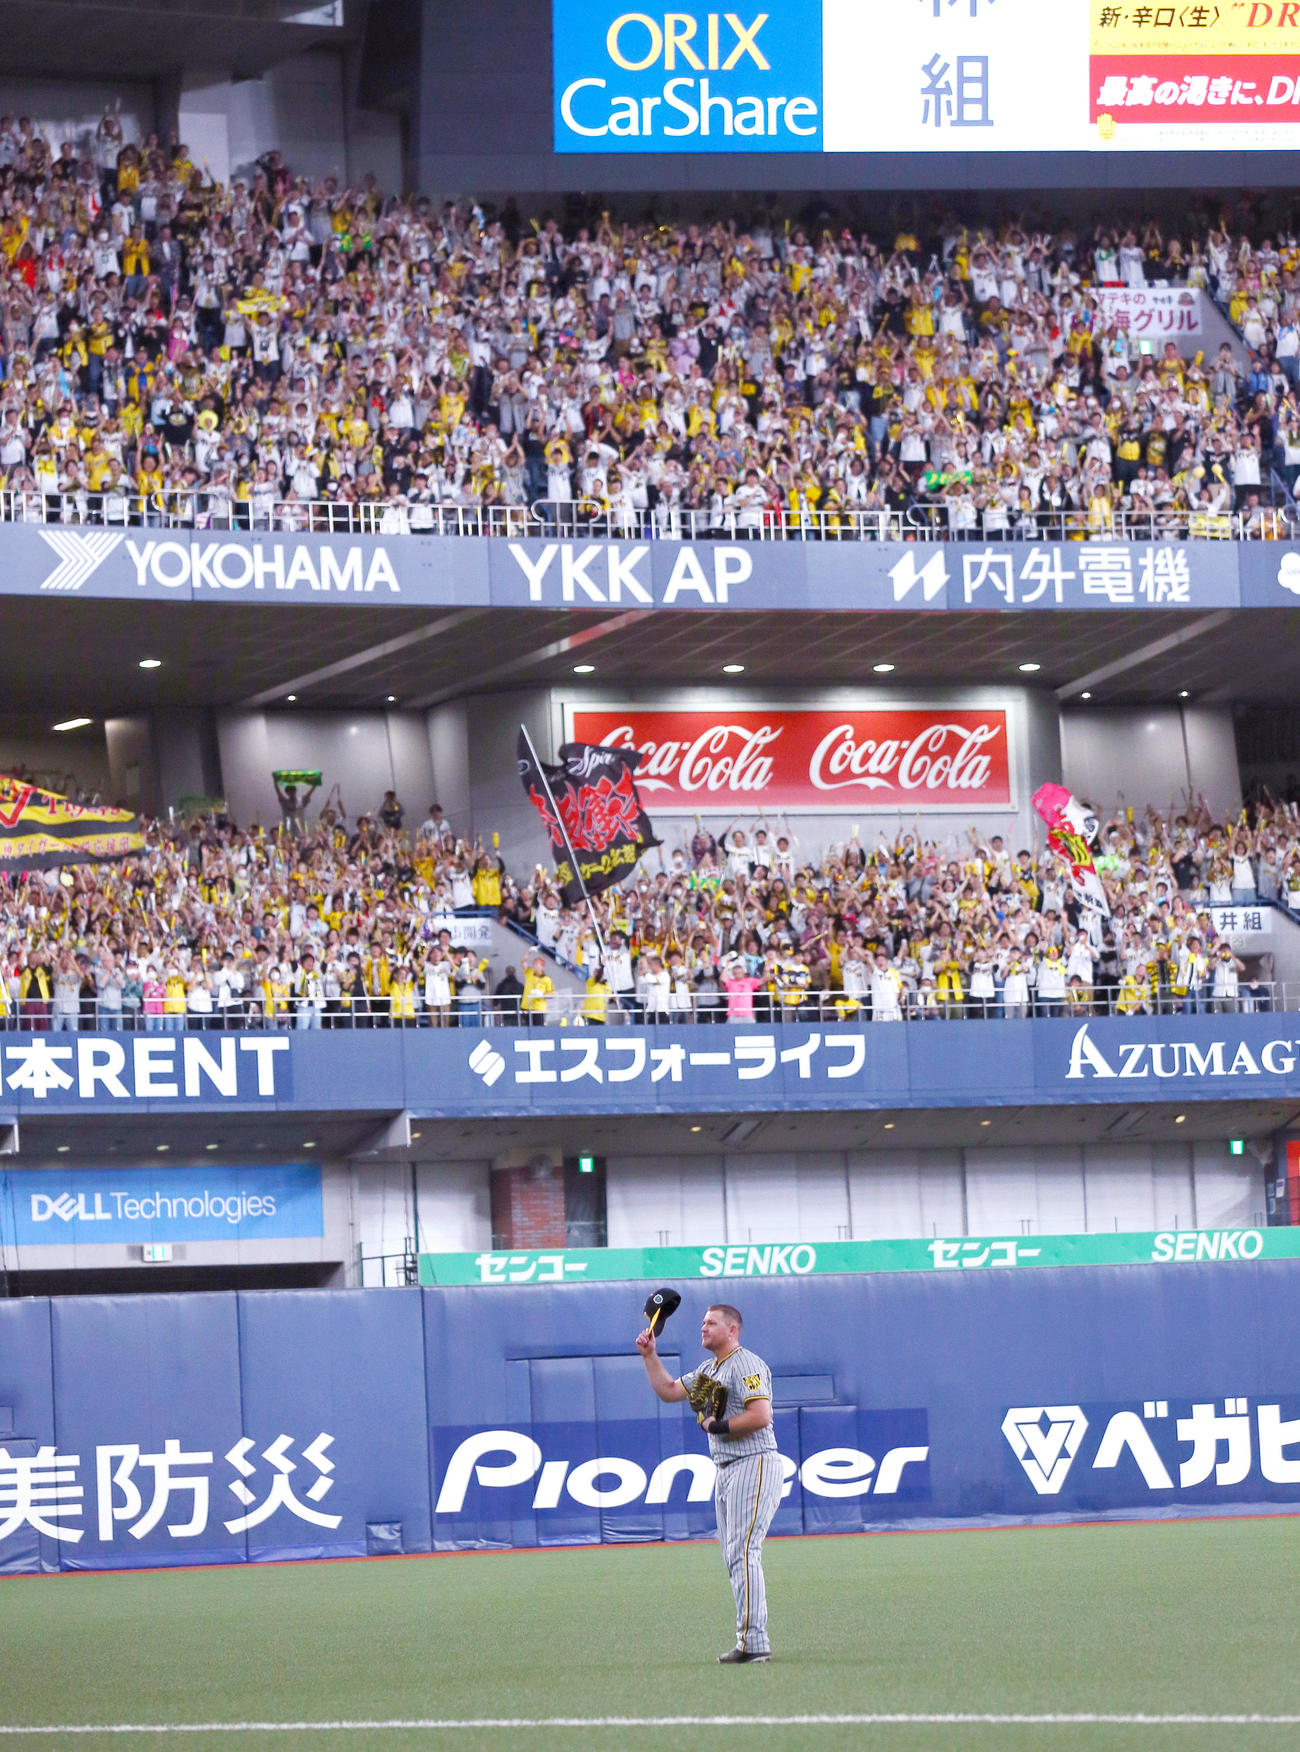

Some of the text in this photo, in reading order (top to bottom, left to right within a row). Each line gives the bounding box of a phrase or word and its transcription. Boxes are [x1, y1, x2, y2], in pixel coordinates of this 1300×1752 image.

[606, 12, 771, 71] ORIX
[560, 77, 818, 137] CarShare
[125, 540, 401, 593] YOKOHAMA
[508, 542, 753, 606] YKK AP
[962, 546, 1190, 604] 内外電機
[809, 723, 1001, 790] Coca-Cola
[0, 1036, 290, 1098] 本RENT
[514, 1033, 867, 1086] エスフォーライフ
[1065, 1022, 1300, 1079] AZUMAG
[31, 1191, 276, 1224] DELL Technologies
[474, 1253, 588, 1283] センコー
[699, 1243, 817, 1278] SENKO
[927, 1239, 1042, 1270] センコー
[1151, 1229, 1264, 1264] SENKO
[435, 1429, 930, 1513] Pioner
